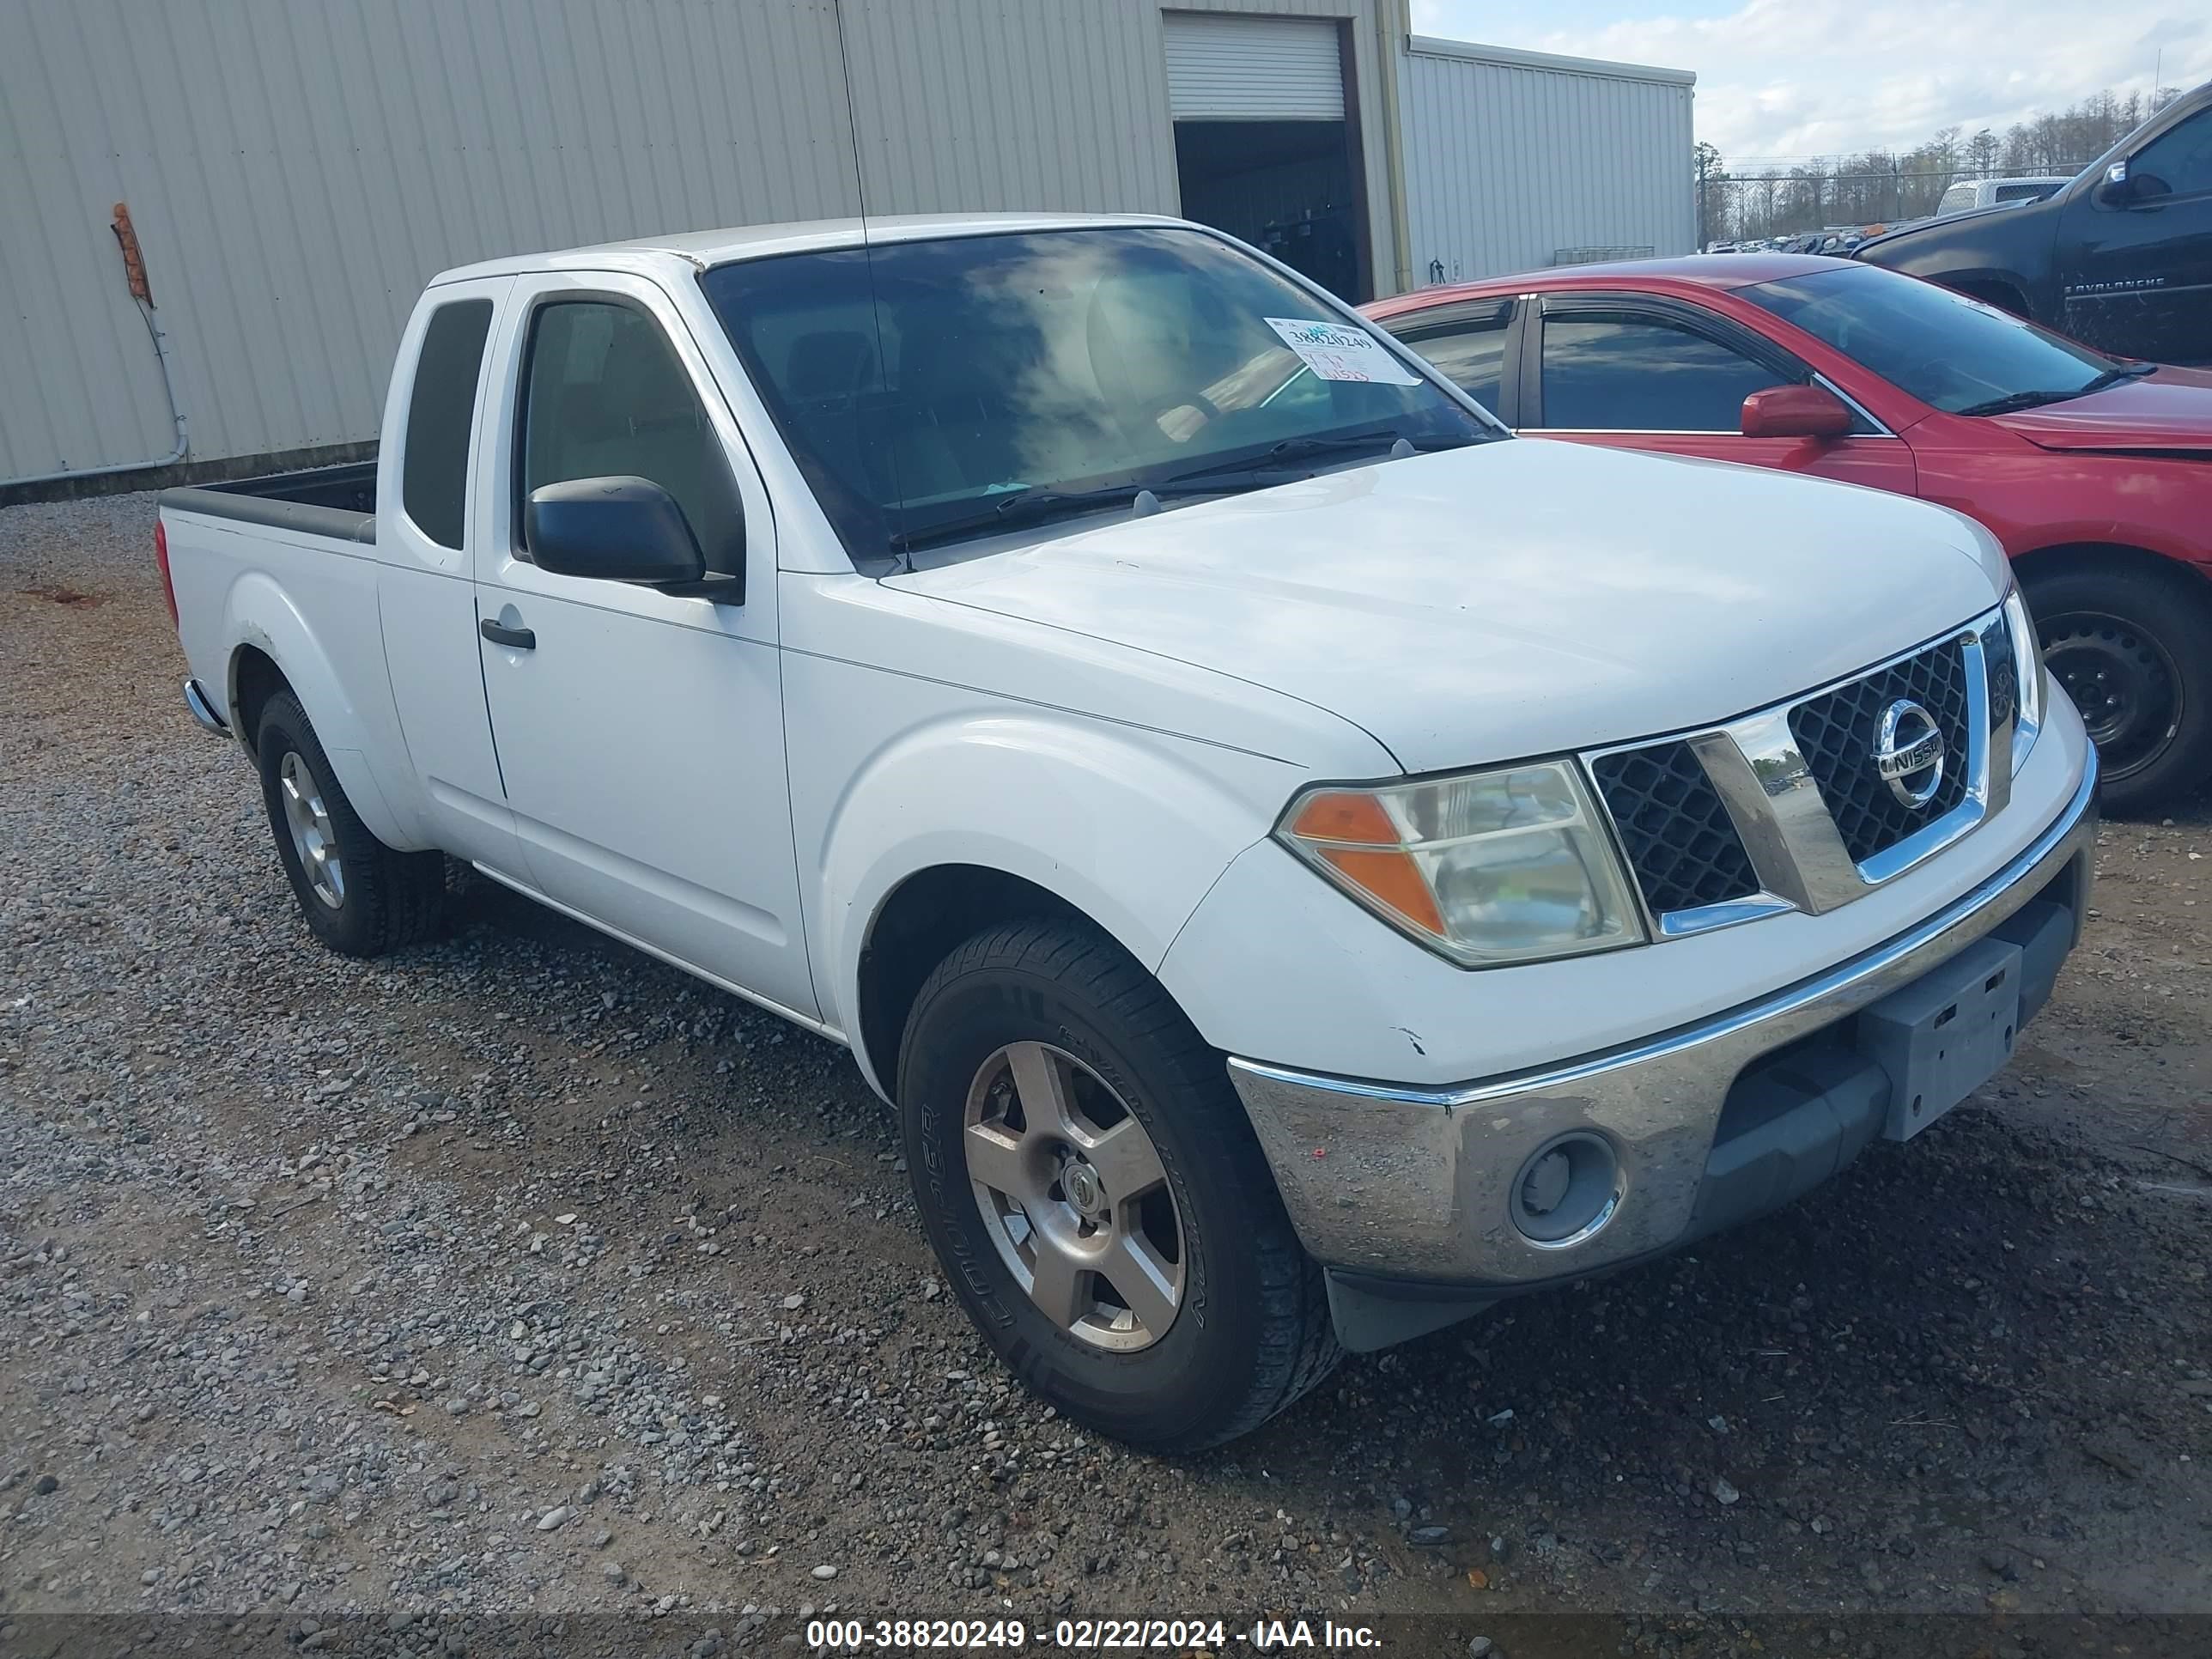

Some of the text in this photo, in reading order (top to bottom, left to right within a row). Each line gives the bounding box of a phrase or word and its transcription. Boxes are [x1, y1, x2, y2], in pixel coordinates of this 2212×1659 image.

[2075, 277, 2165, 293] AVALANCHE
[1288, 331, 1372, 349] 38820249
[1893, 741, 1942, 773] NISSA
